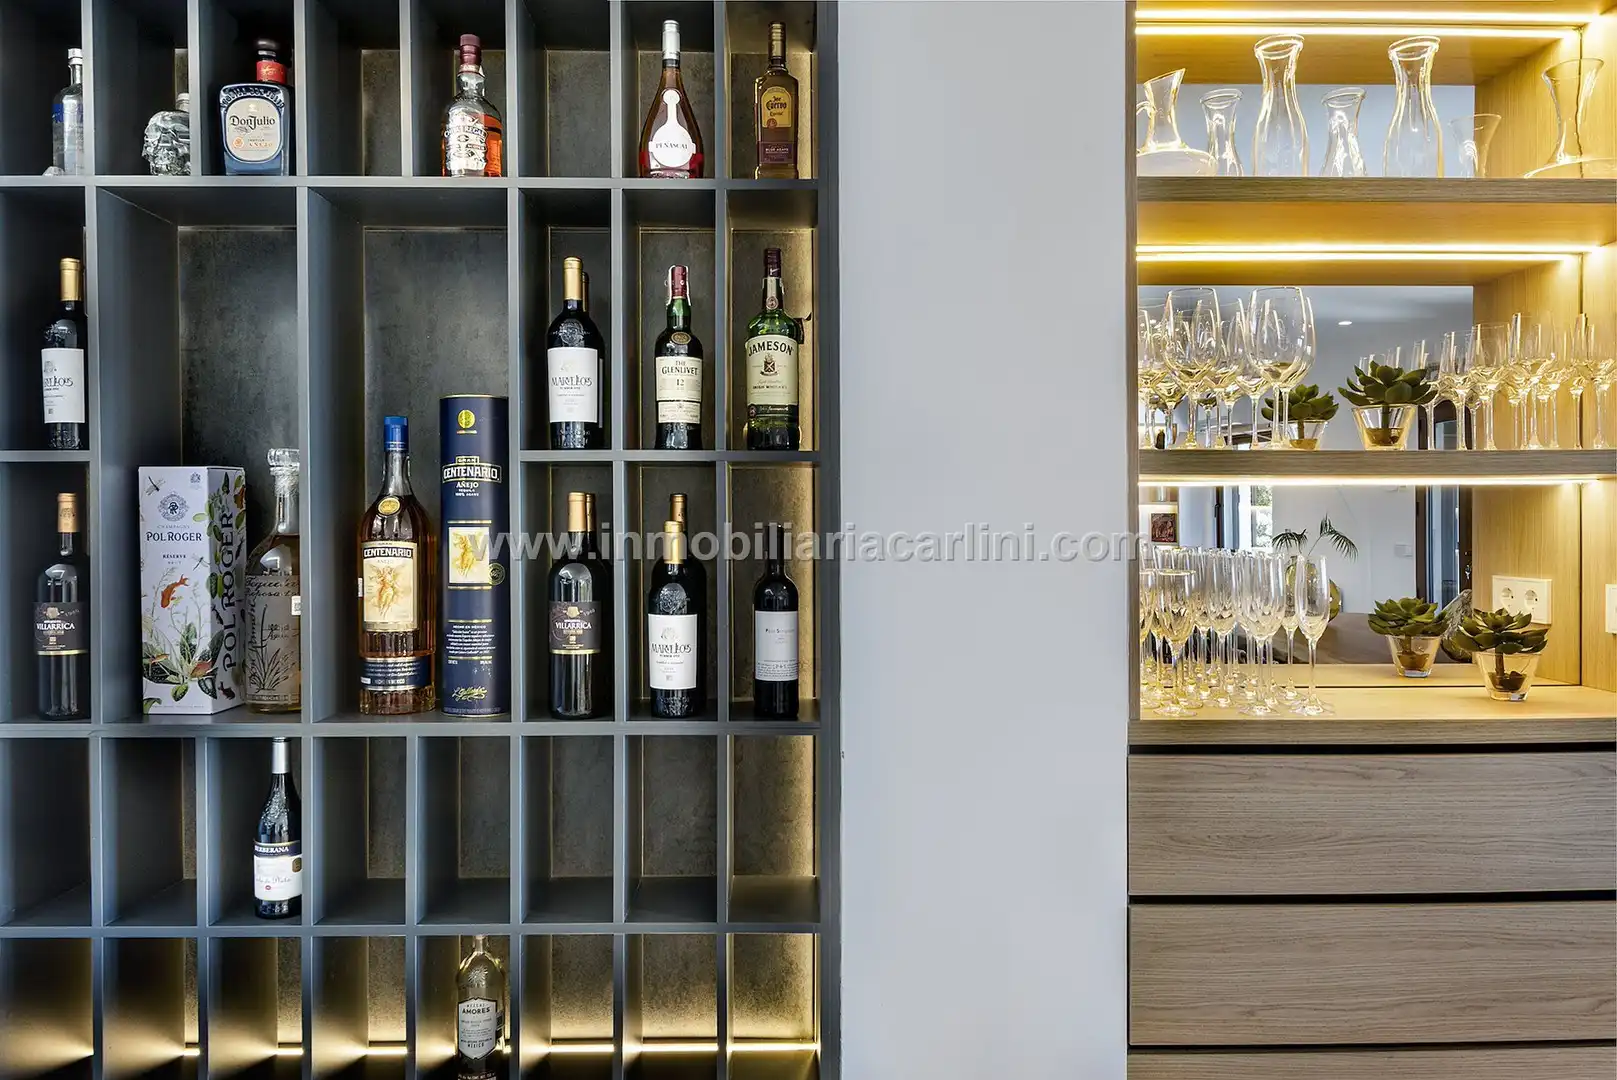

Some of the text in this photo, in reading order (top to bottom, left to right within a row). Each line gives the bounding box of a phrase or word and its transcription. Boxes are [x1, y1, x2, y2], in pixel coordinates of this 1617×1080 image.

[748, 340, 793, 357] JAMESON
[661, 366, 698, 376] GLENLIVET
[676, 378, 685, 386] 12
[443, 466, 499, 480] CENTENARIO
[456, 481, 479, 489] AÑEJO
[146, 531, 202, 542] POL ROGER
[363, 548, 412, 558] CENTENARIO
[221, 513, 237, 671] POL ROGER
[36, 622, 76, 631] VILLARRICA
[555, 621, 592, 630] VILLARRICA
[462, 1006, 491, 1015] AMORES
